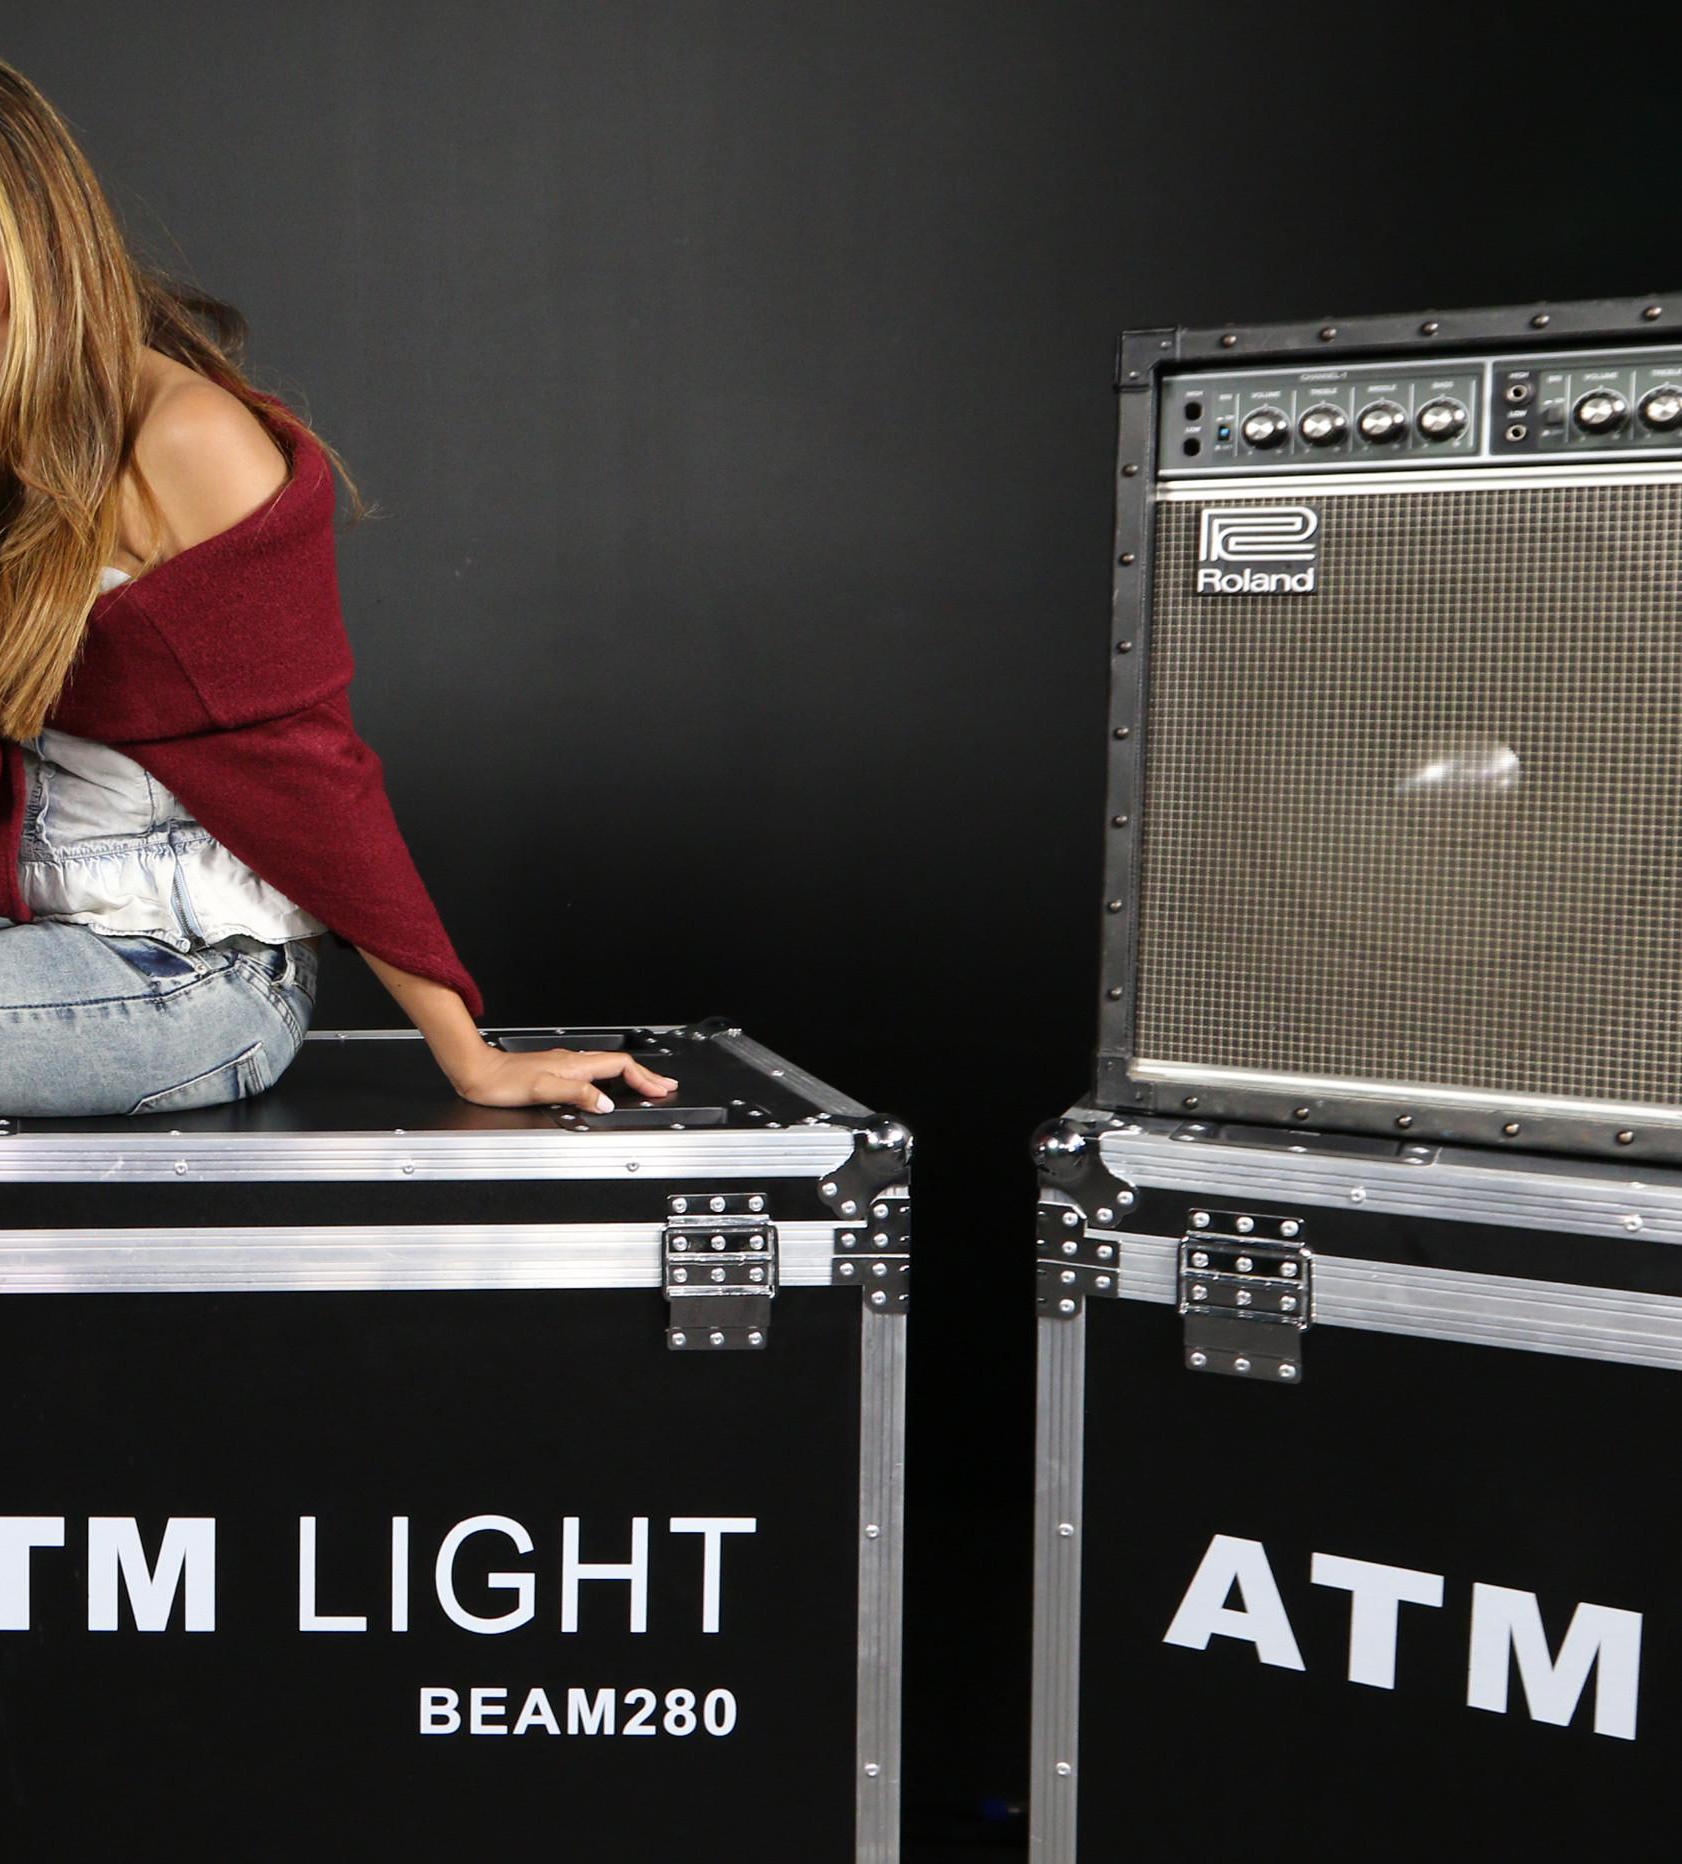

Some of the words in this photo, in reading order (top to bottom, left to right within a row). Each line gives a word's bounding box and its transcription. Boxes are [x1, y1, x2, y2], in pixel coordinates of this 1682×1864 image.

[1197, 567, 1315, 593] Roland
[299, 1514, 757, 1635] LIGHT
[1162, 1533, 1644, 1741] ATM
[419, 1687, 738, 1737] BEAM280
